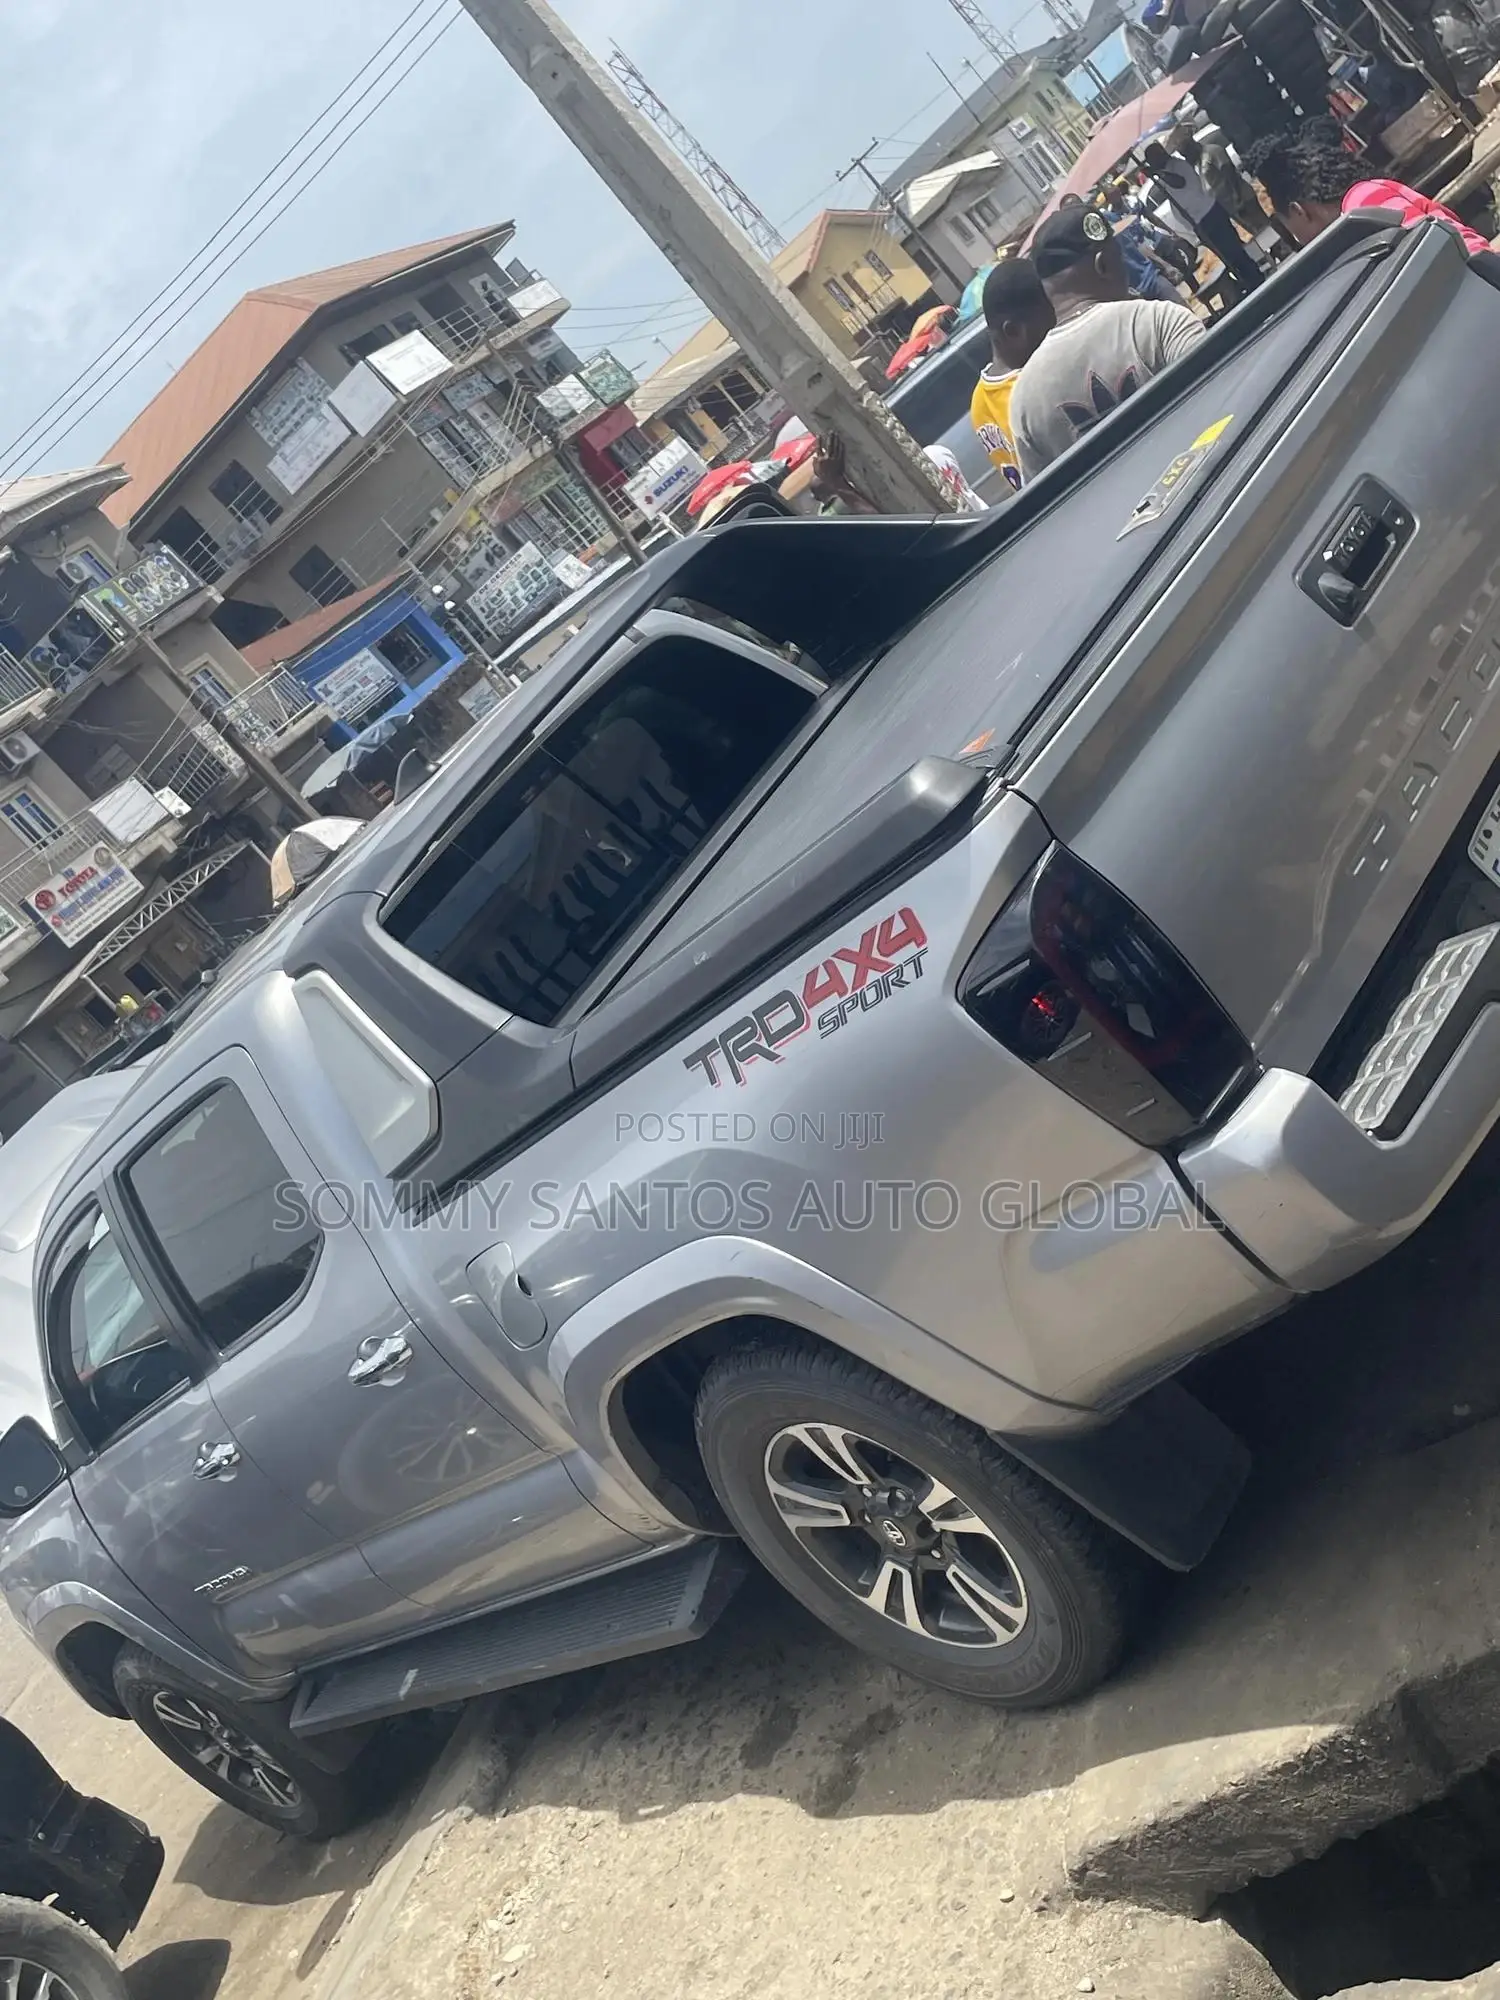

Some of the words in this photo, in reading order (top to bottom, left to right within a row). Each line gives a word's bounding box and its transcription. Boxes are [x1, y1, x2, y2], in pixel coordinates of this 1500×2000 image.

[653, 465, 689, 497] SUZUKI
[1333, 509, 1375, 565] TOYOTA
[58, 866, 98, 898] TOYOTA
[817, 947, 928, 1040] SPORT
[683, 989, 810, 1088] TRD
